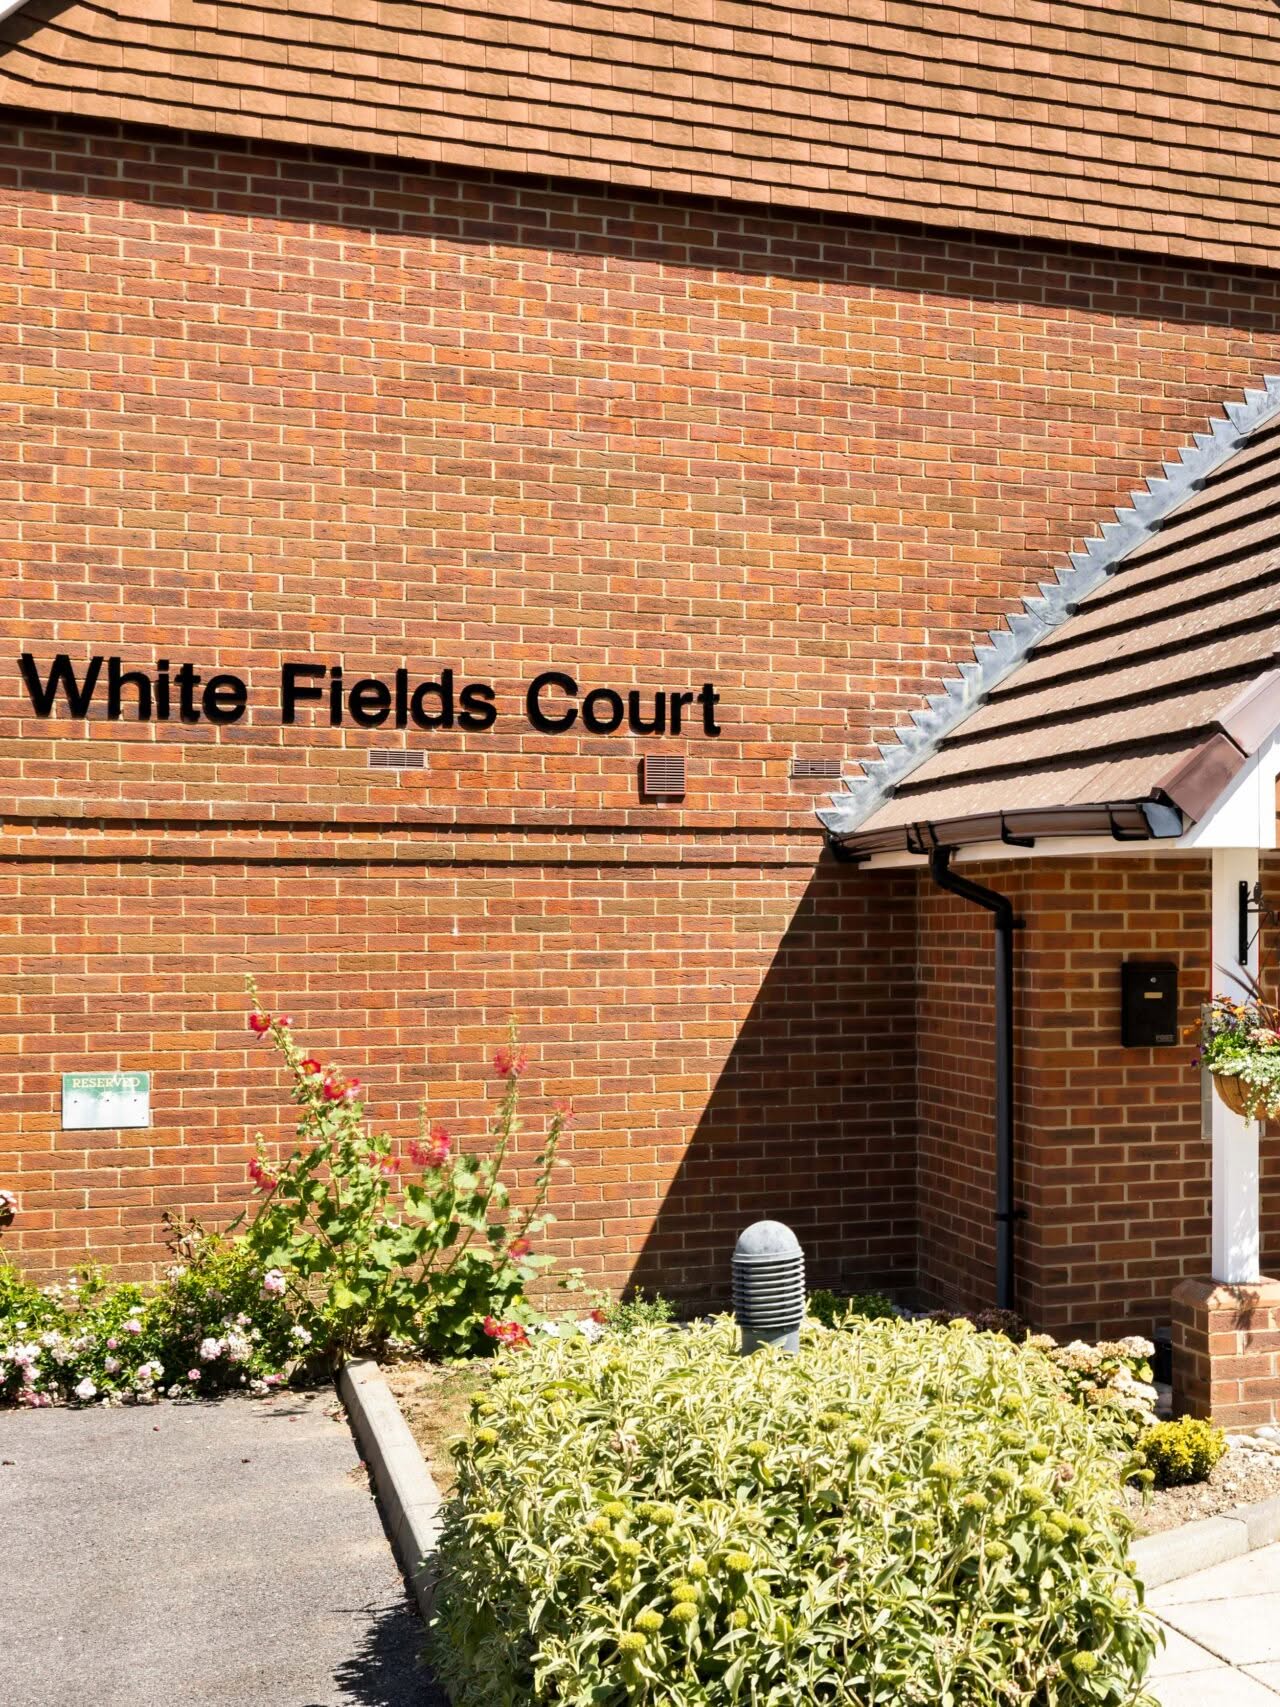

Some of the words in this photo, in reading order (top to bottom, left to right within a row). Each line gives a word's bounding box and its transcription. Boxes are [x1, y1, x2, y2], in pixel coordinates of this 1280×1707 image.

[17, 652, 248, 727] White
[281, 662, 499, 732] Fields
[526, 670, 722, 738] Court
[72, 1077, 141, 1088] RESERVED
